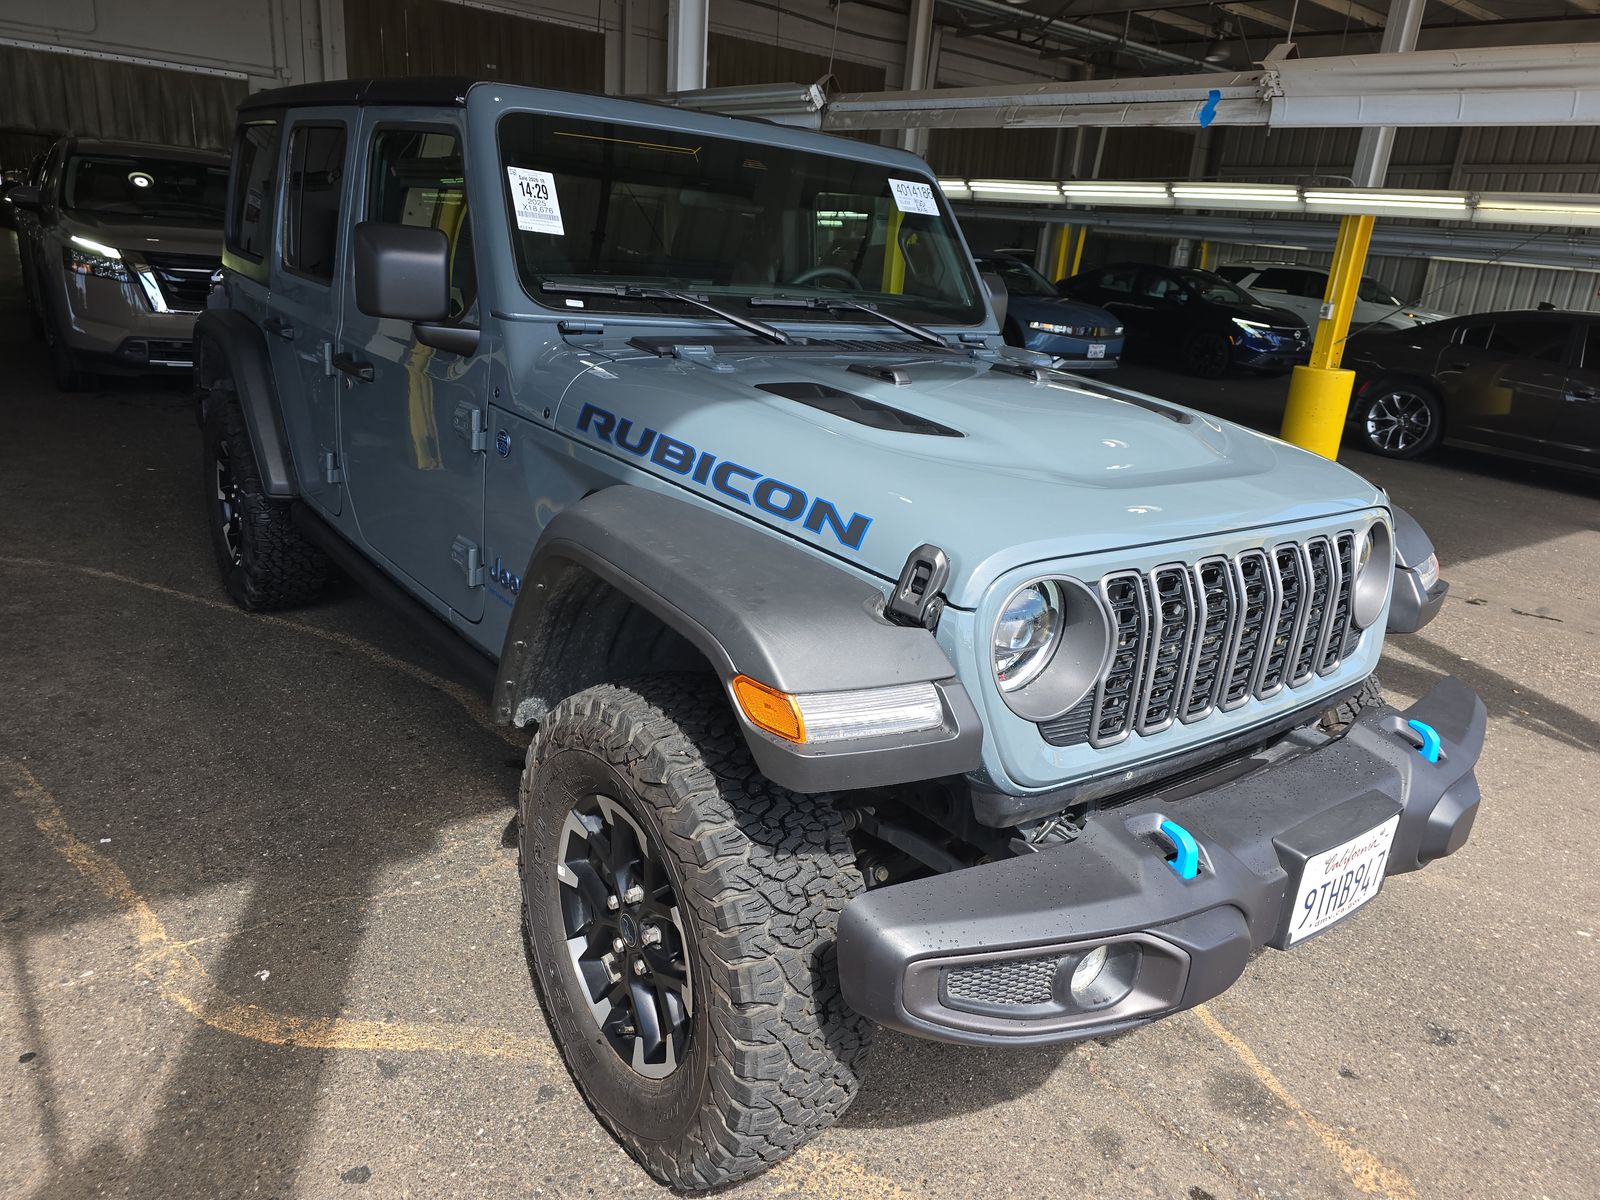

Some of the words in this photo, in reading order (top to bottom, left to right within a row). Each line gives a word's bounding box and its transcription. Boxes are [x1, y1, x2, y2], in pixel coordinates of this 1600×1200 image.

[518, 181, 549, 200] 14:29
[527, 198, 547, 207] 2025
[576, 402, 874, 551] RUBICON
[1324, 836, 1381, 875] California
[1297, 849, 1387, 931] 9THB947
